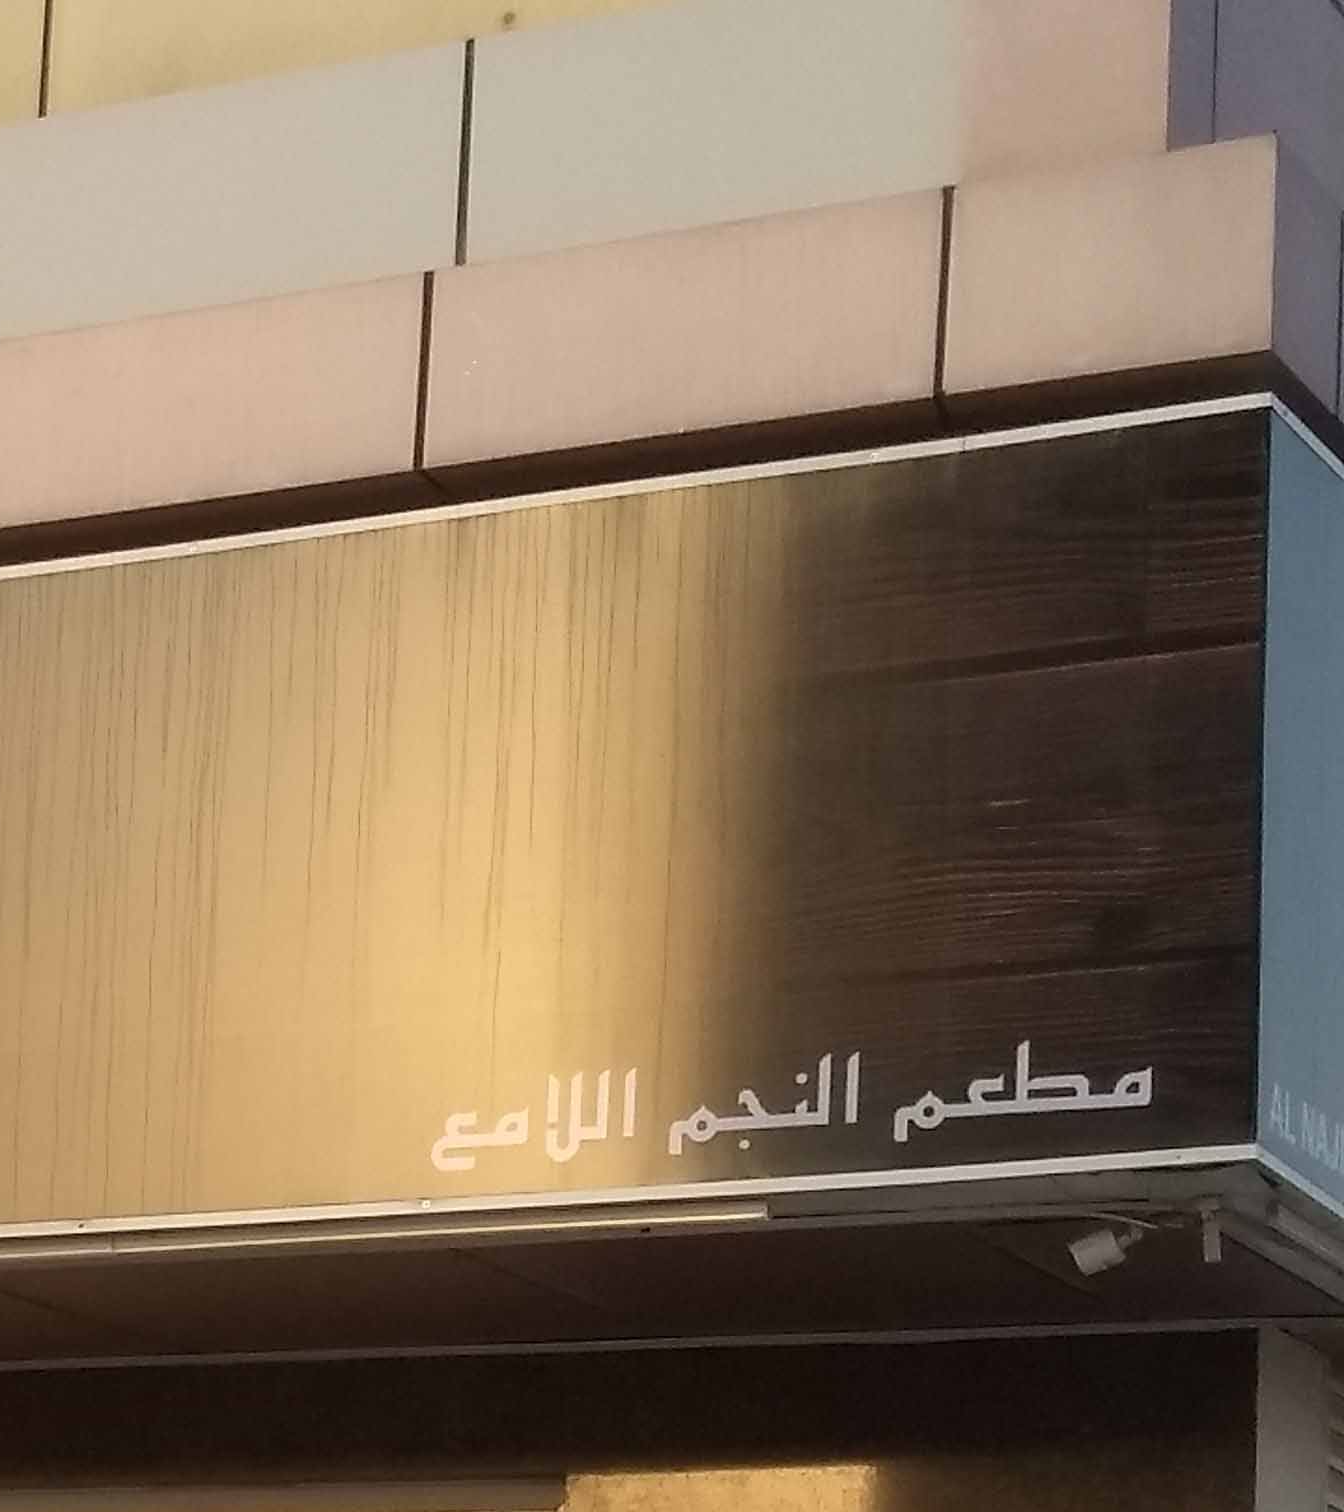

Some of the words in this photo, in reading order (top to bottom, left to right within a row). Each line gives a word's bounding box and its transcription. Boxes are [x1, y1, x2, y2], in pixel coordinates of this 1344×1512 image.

[430, 1067, 638, 1171] اللامع
[667, 1051, 861, 1156] النجم
[893, 1039, 1154, 1143] مطعم
